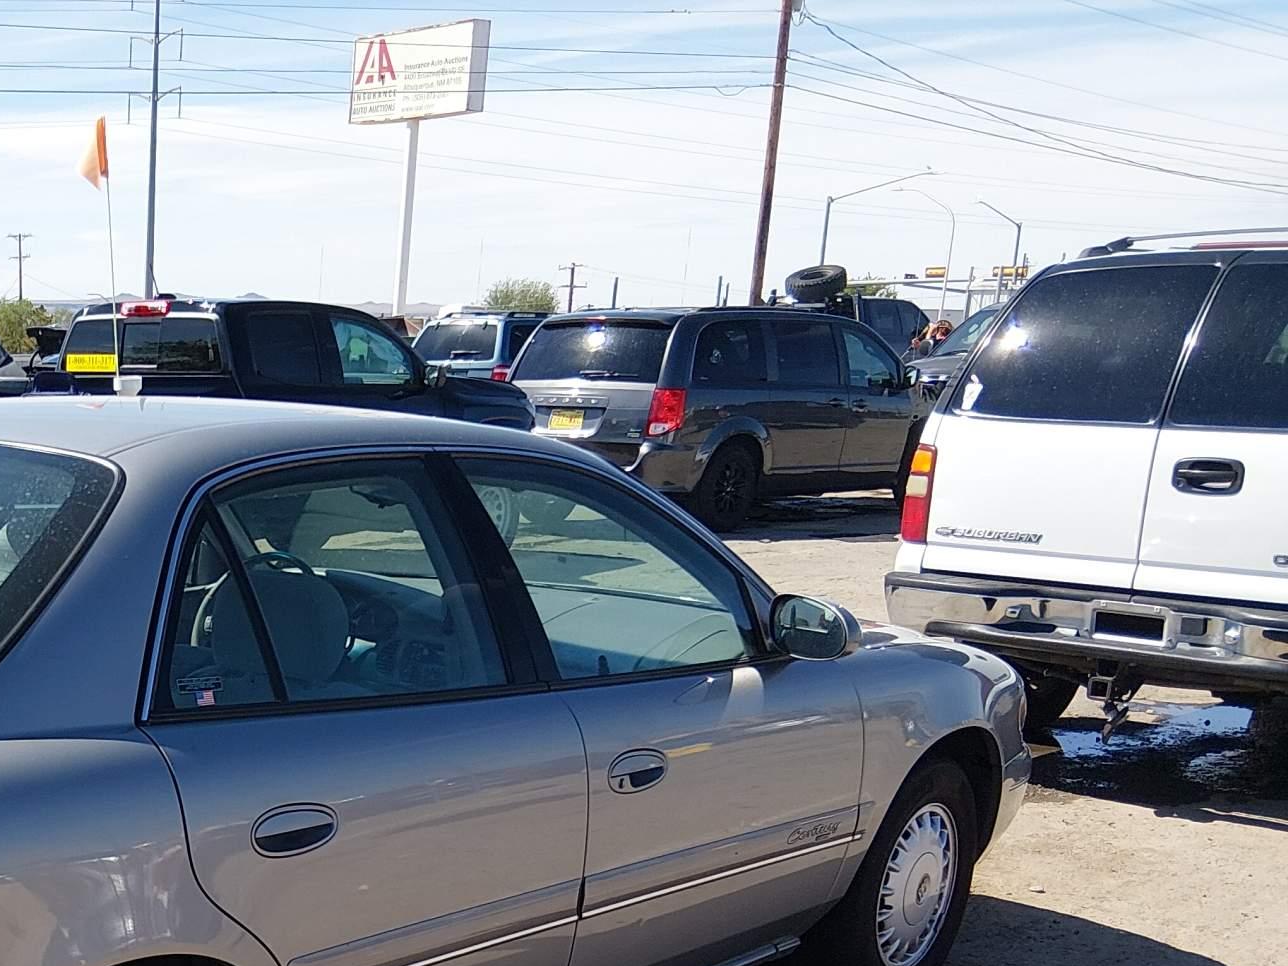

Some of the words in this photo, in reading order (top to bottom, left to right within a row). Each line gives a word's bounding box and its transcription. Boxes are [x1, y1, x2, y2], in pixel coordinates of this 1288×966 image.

[444, 56, 468, 65] Auctions
[353, 89, 397, 102] INSURANCE
[353, 105, 367, 115] AUTO
[368, 103, 396, 113] AUCTIONS
[953, 527, 1043, 545] SUBURBAN
